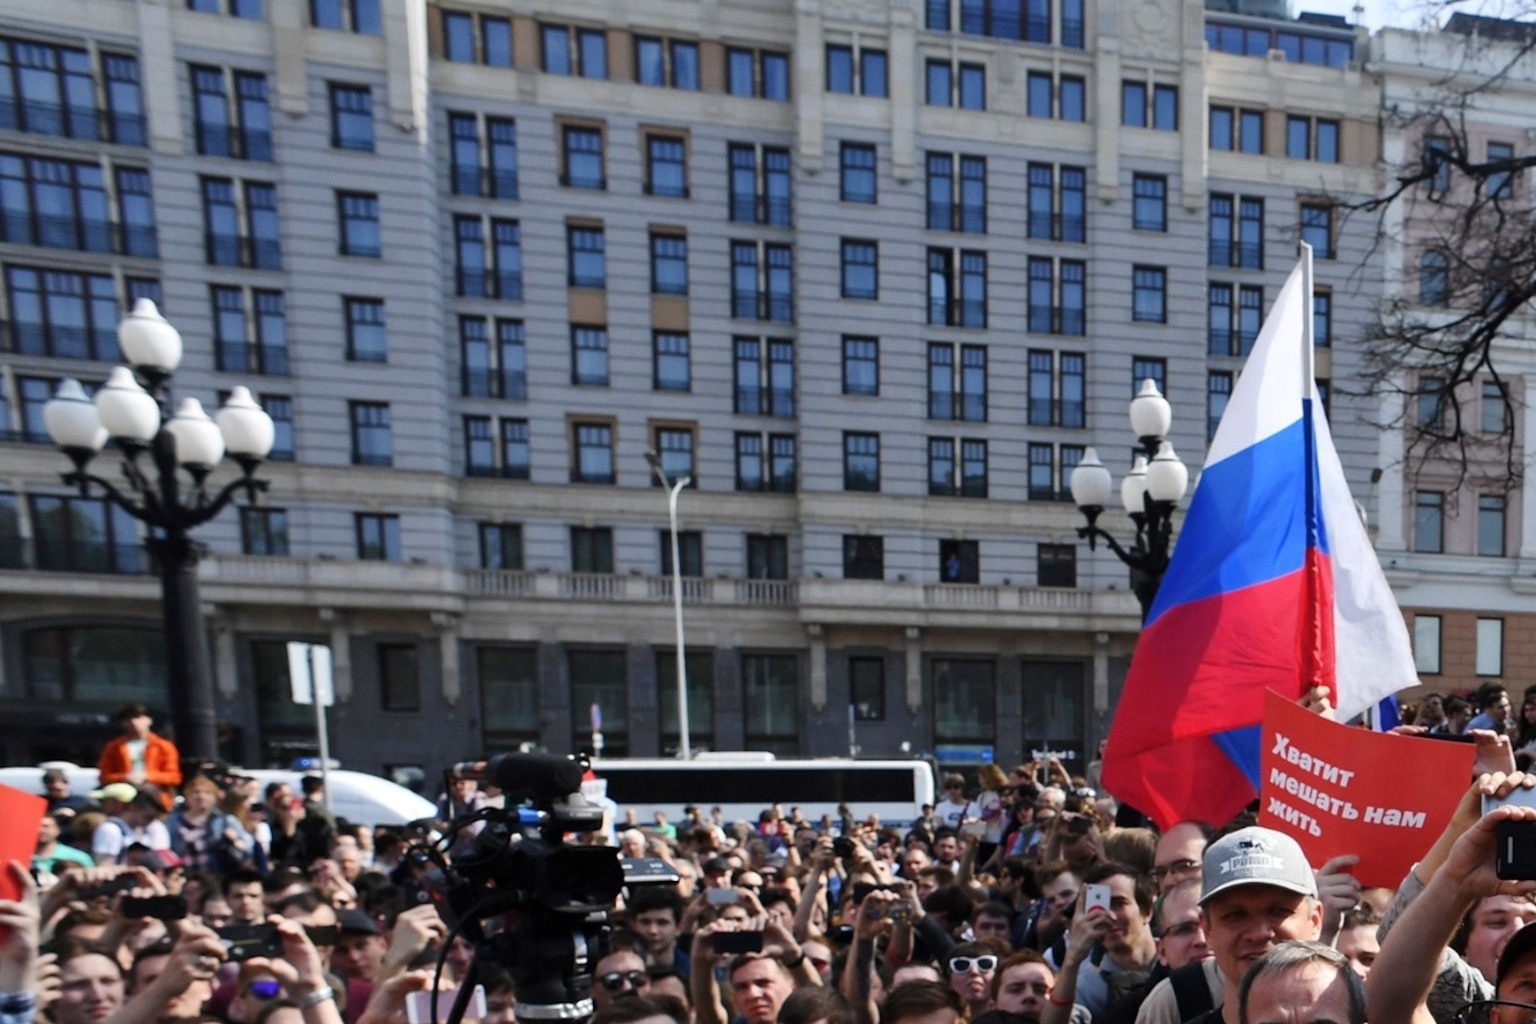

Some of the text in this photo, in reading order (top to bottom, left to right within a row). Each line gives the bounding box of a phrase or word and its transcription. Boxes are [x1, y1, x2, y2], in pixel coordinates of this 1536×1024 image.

[1271, 732, 1354, 788] Хватит
[1266, 797, 1322, 837] жить
[1269, 767, 1427, 828] мешать нам
